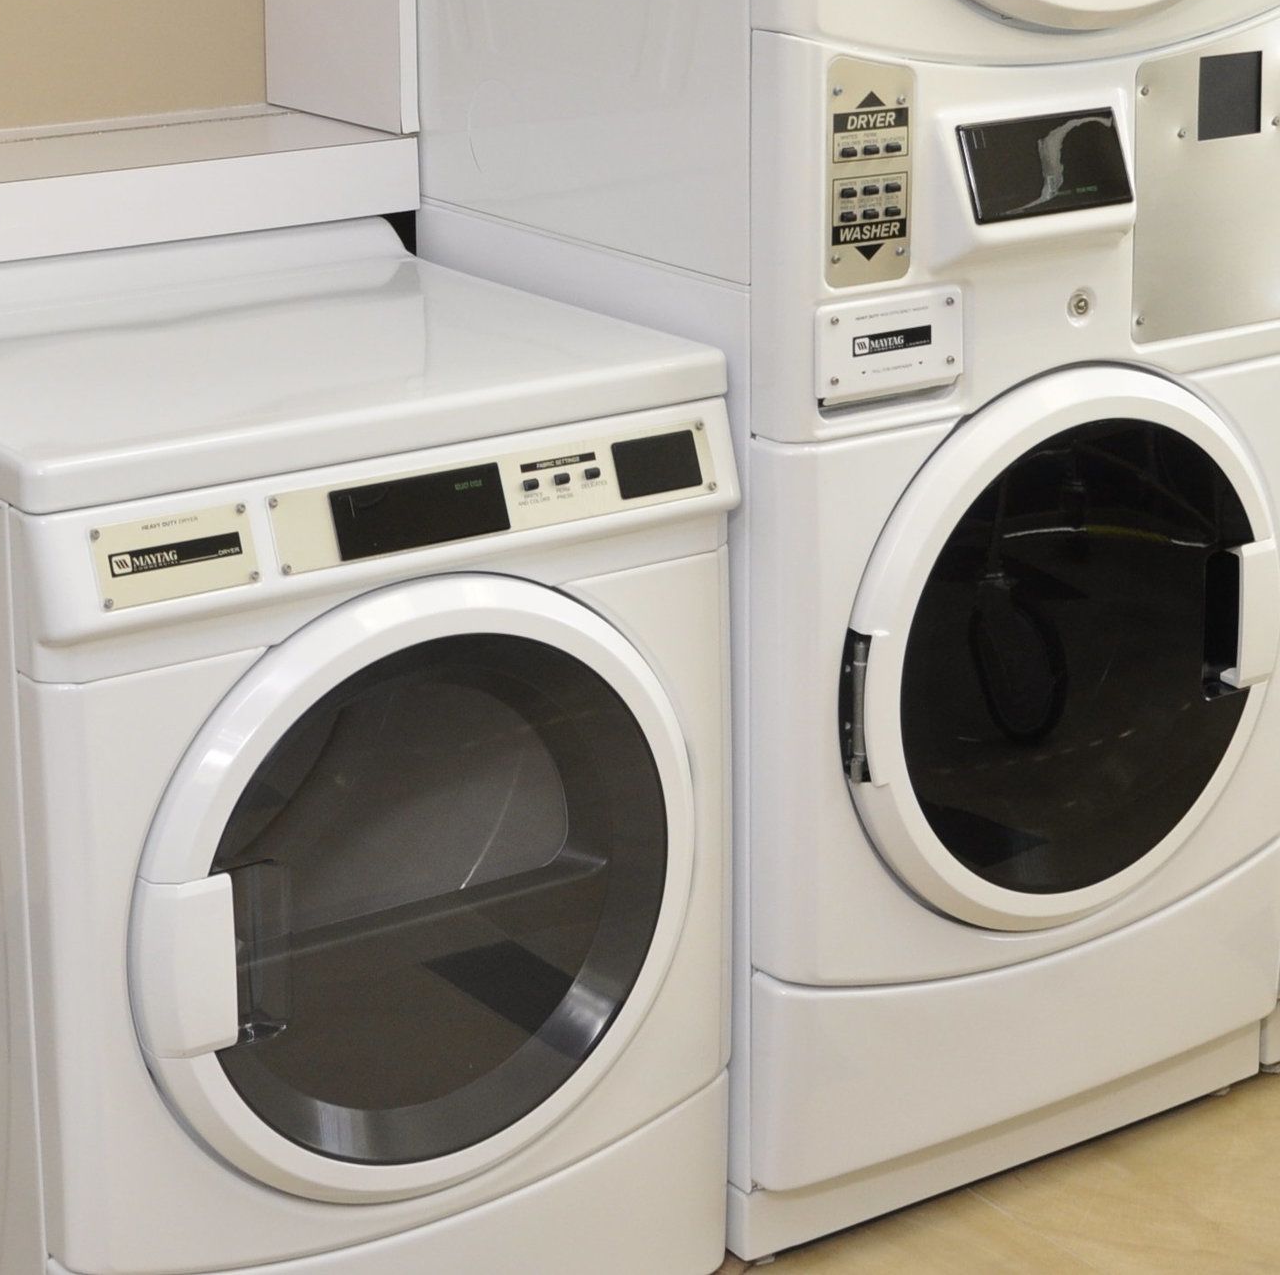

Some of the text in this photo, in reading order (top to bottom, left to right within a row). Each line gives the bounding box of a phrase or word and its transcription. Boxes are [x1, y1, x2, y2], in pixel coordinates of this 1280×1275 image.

[847, 112, 896, 130] DRYER
[840, 222, 900, 242] WASHER
[870, 335, 904, 349] MAYTAG
[141, 522, 161, 531] HEAVY
[162, 519, 178, 528] DUTY
[132, 550, 178, 567] MAYTAG
[218, 546, 241, 556] DRYER
